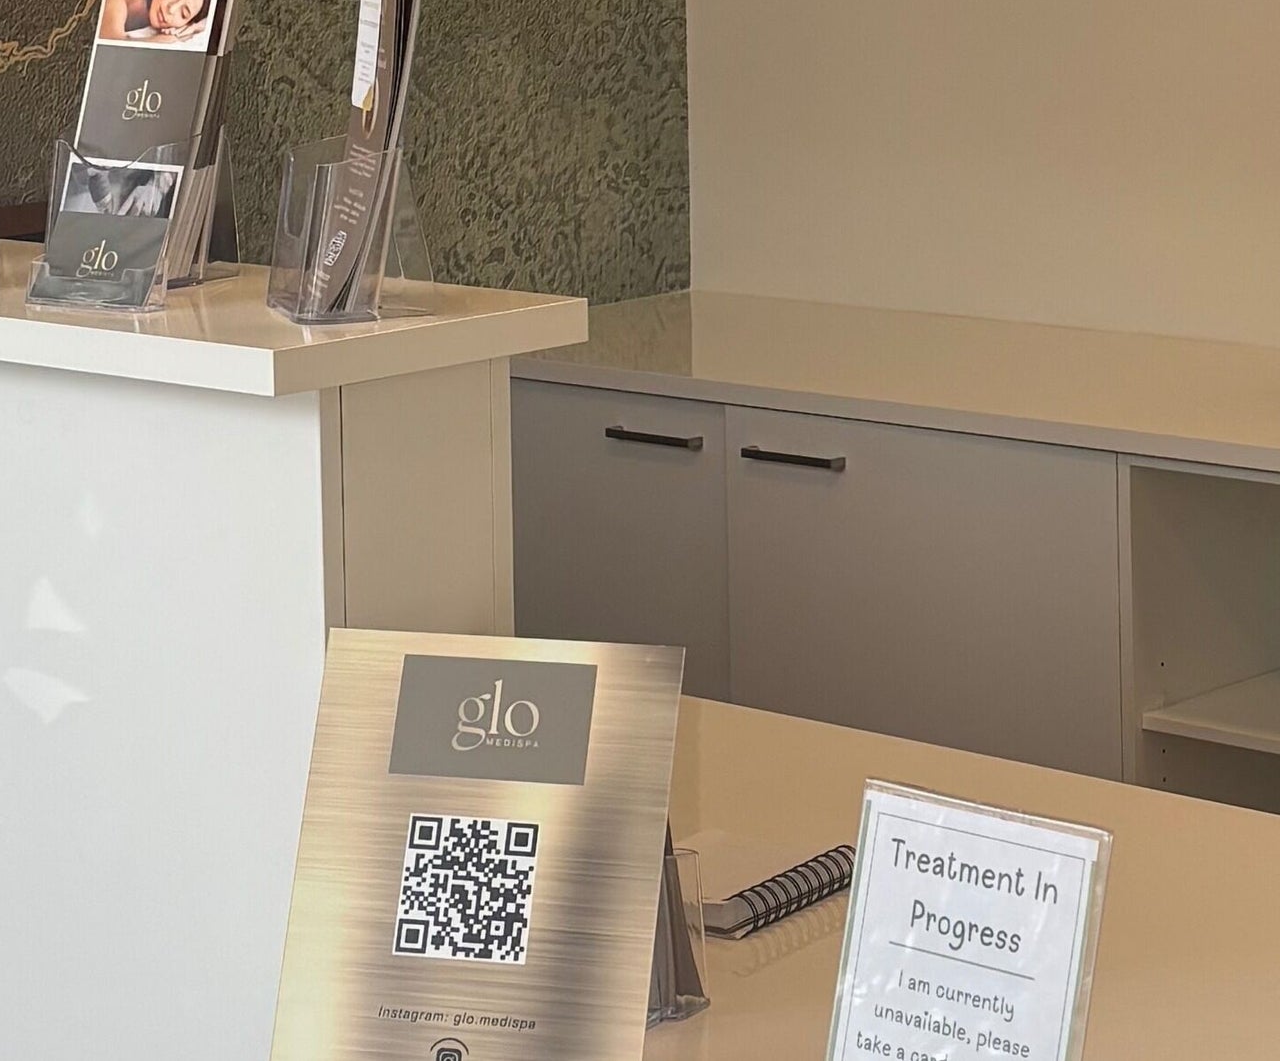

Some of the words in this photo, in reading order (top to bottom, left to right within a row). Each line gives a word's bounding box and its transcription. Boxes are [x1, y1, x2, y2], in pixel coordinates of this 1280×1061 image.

[121, 79, 161, 120] glo
[75, 239, 118, 278] glo
[451, 679, 540, 751] glo
[485, 737, 540, 749] MEDISPA
[891, 837, 1025, 897] Treatment
[1033, 871, 1059, 905] In
[910, 899, 1022, 954] Progress
[378, 1004, 449, 1023] Instagram:
[453, 1012, 537, 1032] glo.medispa
[898, 969, 904, 988] I
[907, 977, 931, 995] am
[935, 984, 1015, 1023] currently
[856, 1030, 891, 1057] take
[896, 1047, 905, 1060] a
[874, 1003, 971, 1045] unavailable,
[976, 1031, 1031, 1059] please
